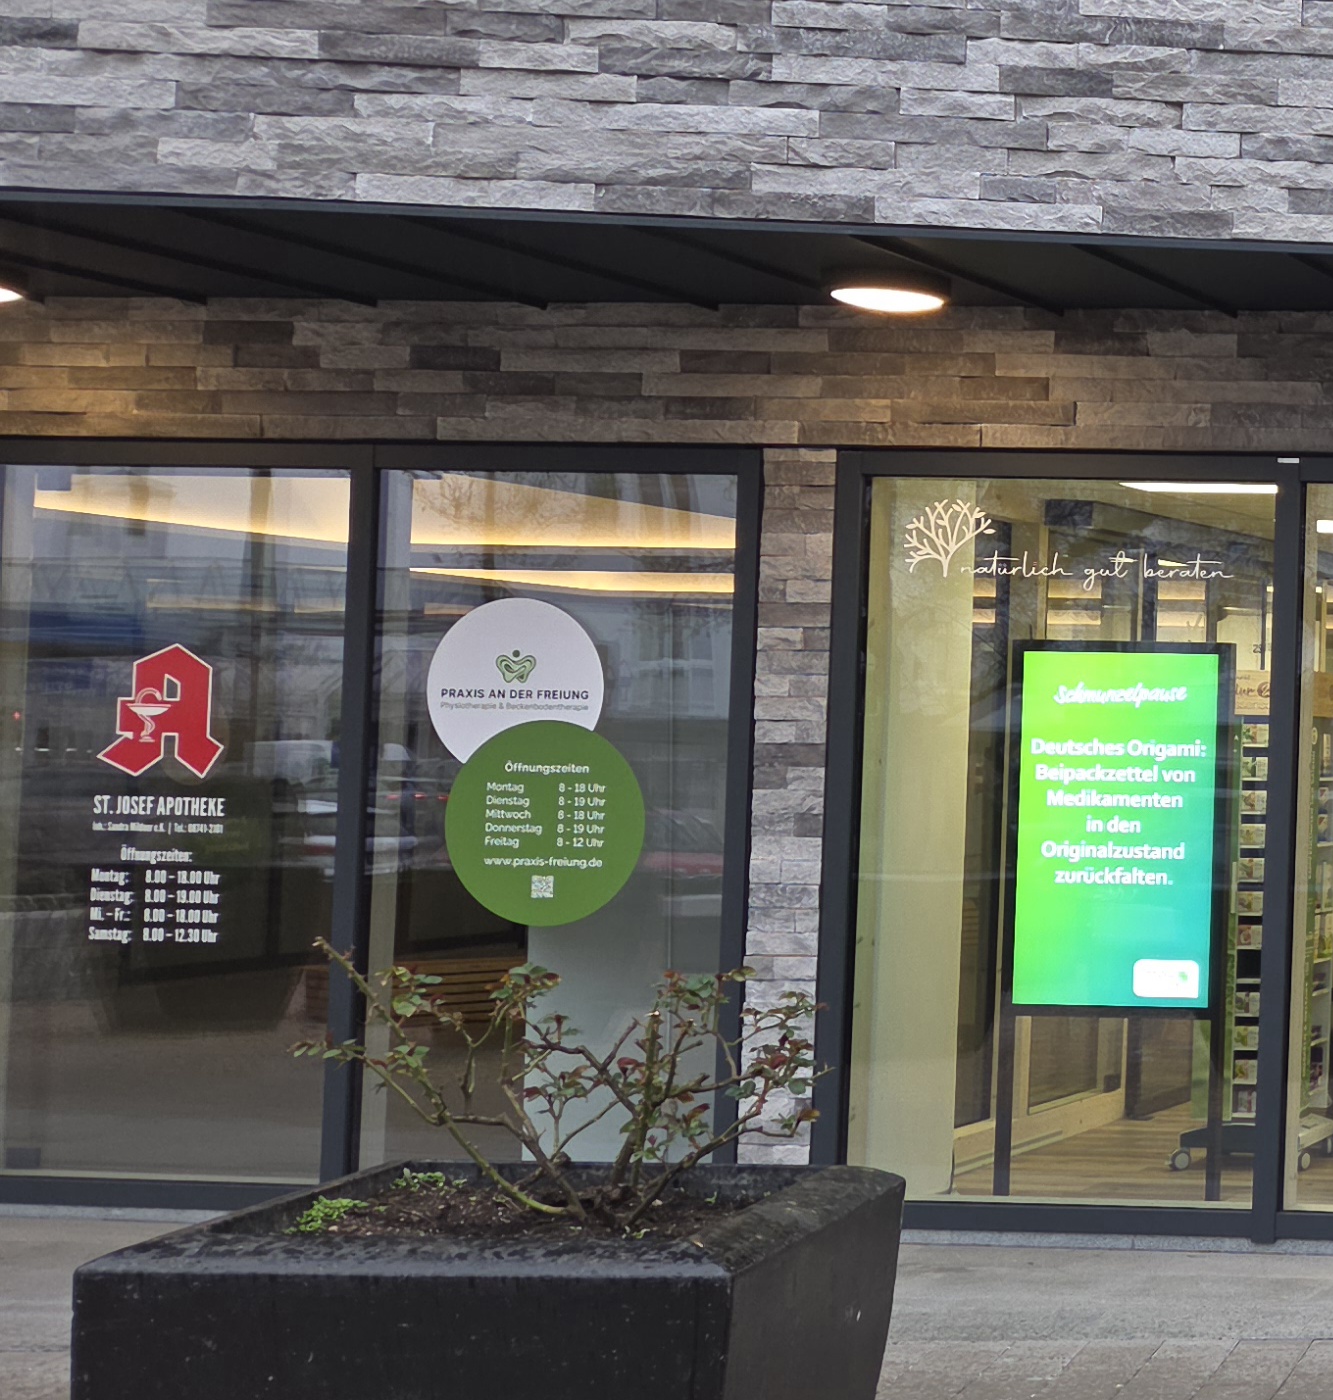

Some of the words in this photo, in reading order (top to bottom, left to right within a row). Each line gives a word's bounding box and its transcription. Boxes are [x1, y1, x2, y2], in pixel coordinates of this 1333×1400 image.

[960, 551, 1073, 578] natürlich
[1083, 551, 1139, 591] gut
[1143, 553, 1235, 579] beraten
[440, 688, 485, 698] PRAXIS
[488, 689, 506, 698] AN
[509, 689, 533, 699] DER
[537, 690, 589, 700] FREIUNG
[1053, 682, 1188, 708] Schmunzelpause
[440, 702, 497, 711] Physiotherapie
[498, 702, 504, 710] &
[506, 702, 589, 712] Beckenbodentherapie
[1030, 738, 1124, 757] Deutsches
[1127, 739, 1207, 762] Origami:
[504, 760, 590, 775] Öffnungszeiten
[1035, 764, 1158, 785] Beipackzettel
[1161, 767, 1196, 783] von
[486, 782, 525, 794] Montag
[558, 783, 565, 792] 8
[574, 783, 586, 793] 18
[587, 783, 606, 793] Uhr
[93, 795, 113, 815] ST.
[116, 795, 155, 815] JOSEF
[156, 796, 227, 817] APOTHEKE
[485, 795, 530, 808] Dienstag
[558, 796, 565, 806] 8
[574, 797, 585, 806] 19
[587, 797, 606, 807] Uhr
[1046, 789, 1183, 808] Medikamenten
[485, 808, 531, 819] Mittwoch
[557, 810, 564, 819] 8
[573, 810, 585, 820] 18
[586, 810, 605, 820] Uhr
[484, 822, 543, 836] Donnerstag
[557, 823, 564, 833] 8
[573, 824, 584, 834] 19
[586, 824, 605, 834] Uhr
[1086, 815, 1104, 833] in
[1106, 816, 1141, 834] den
[484, 836, 520, 848] Freitag
[556, 837, 563, 847] 8
[572, 838, 584, 847] 12
[585, 838, 604, 848] Uhr
[1041, 840, 1185, 862] Originalzustand
[120, 844, 193, 864] Öffnungszeiten:
[483, 857, 603, 869] www.praxis-freiung.de
[90, 868, 130, 886] Montag:
[145, 870, 167, 884] 8.00
[203, 871, 221, 885] Uhr
[1055, 866, 1173, 886] zurückfalten.
[89, 887, 135, 905] Dienstag:
[144, 889, 166, 903] 8.00
[176, 889, 201, 903] 19.00
[202, 889, 220, 904] Uhr
[89, 907, 105, 921] Mi.
[201, 909, 219, 924] Uhr
[88, 926, 133, 944] Samstag:
[142, 927, 165, 942] 8.00
[174, 928, 200, 942] 12.30
[201, 929, 219, 943] Uhr
